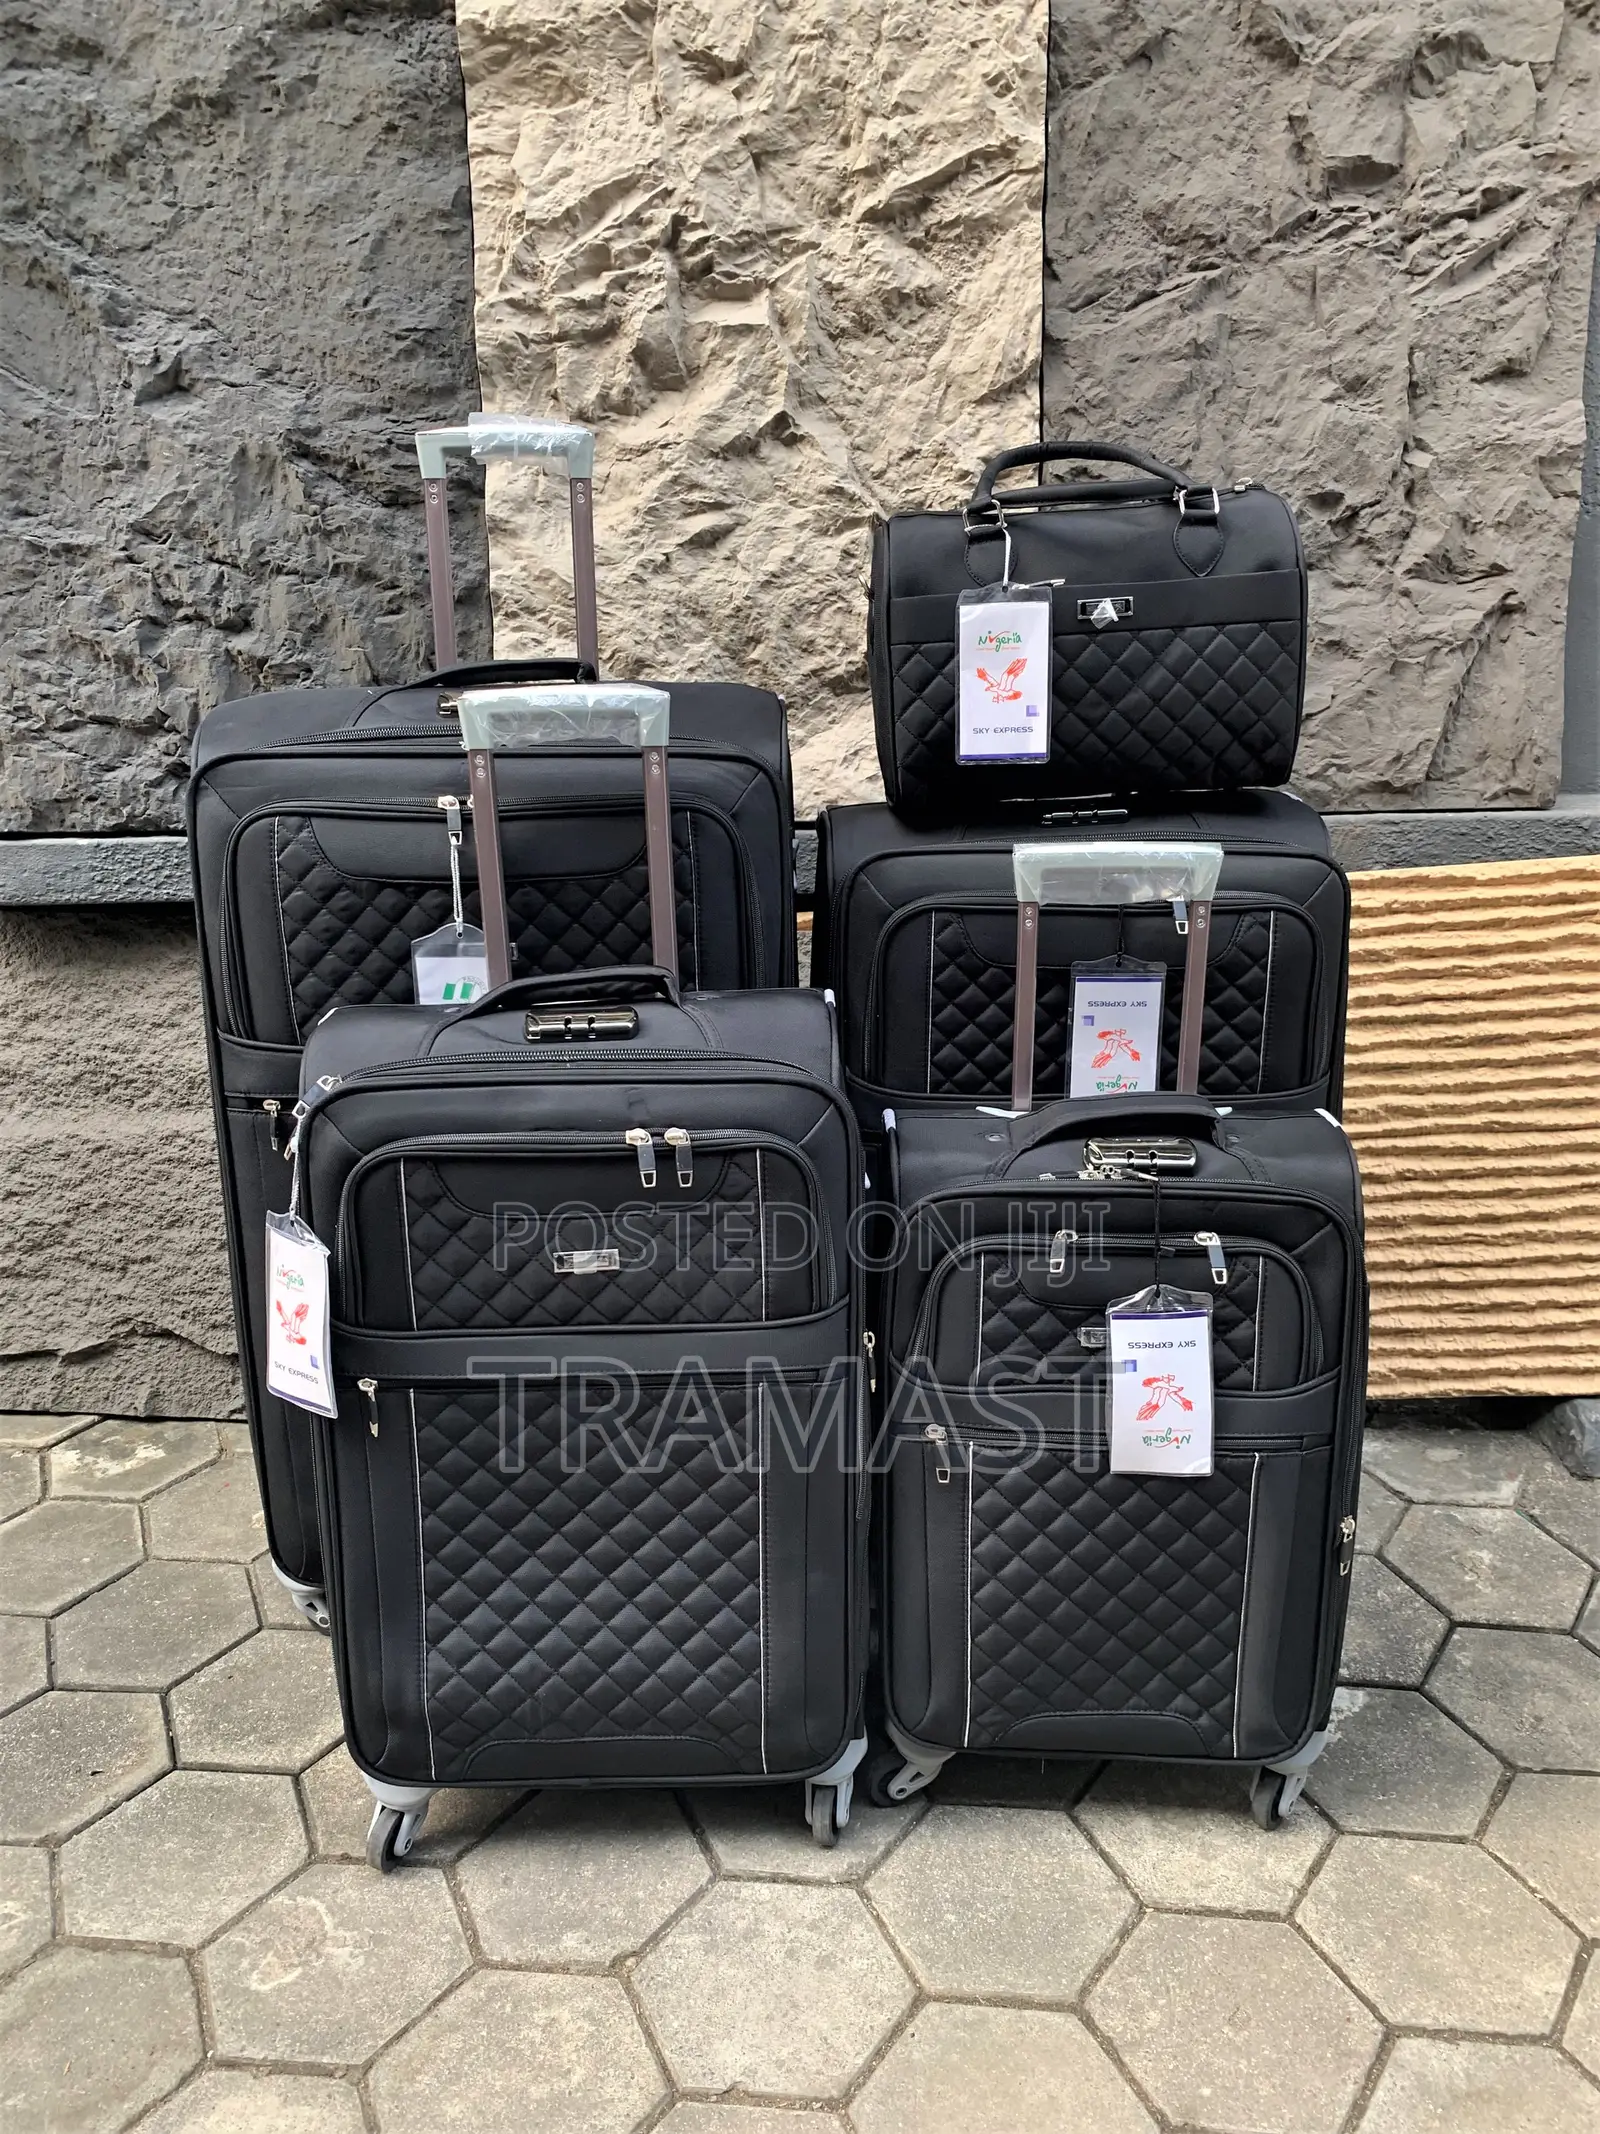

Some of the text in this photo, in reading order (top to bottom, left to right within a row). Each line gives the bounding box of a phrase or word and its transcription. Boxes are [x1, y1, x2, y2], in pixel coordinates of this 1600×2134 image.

[977, 630, 1023, 653] Nigeria
[972, 725, 1034, 735] SKY EXPRESS
[1087, 1000, 1148, 1008] SKY EXPRESS
[1127, 1340, 1197, 1350] SKY EXPRESS
[274, 1361, 319, 1385] SKY EXPRESS
[1141, 1426, 1192, 1450] Nigeria
